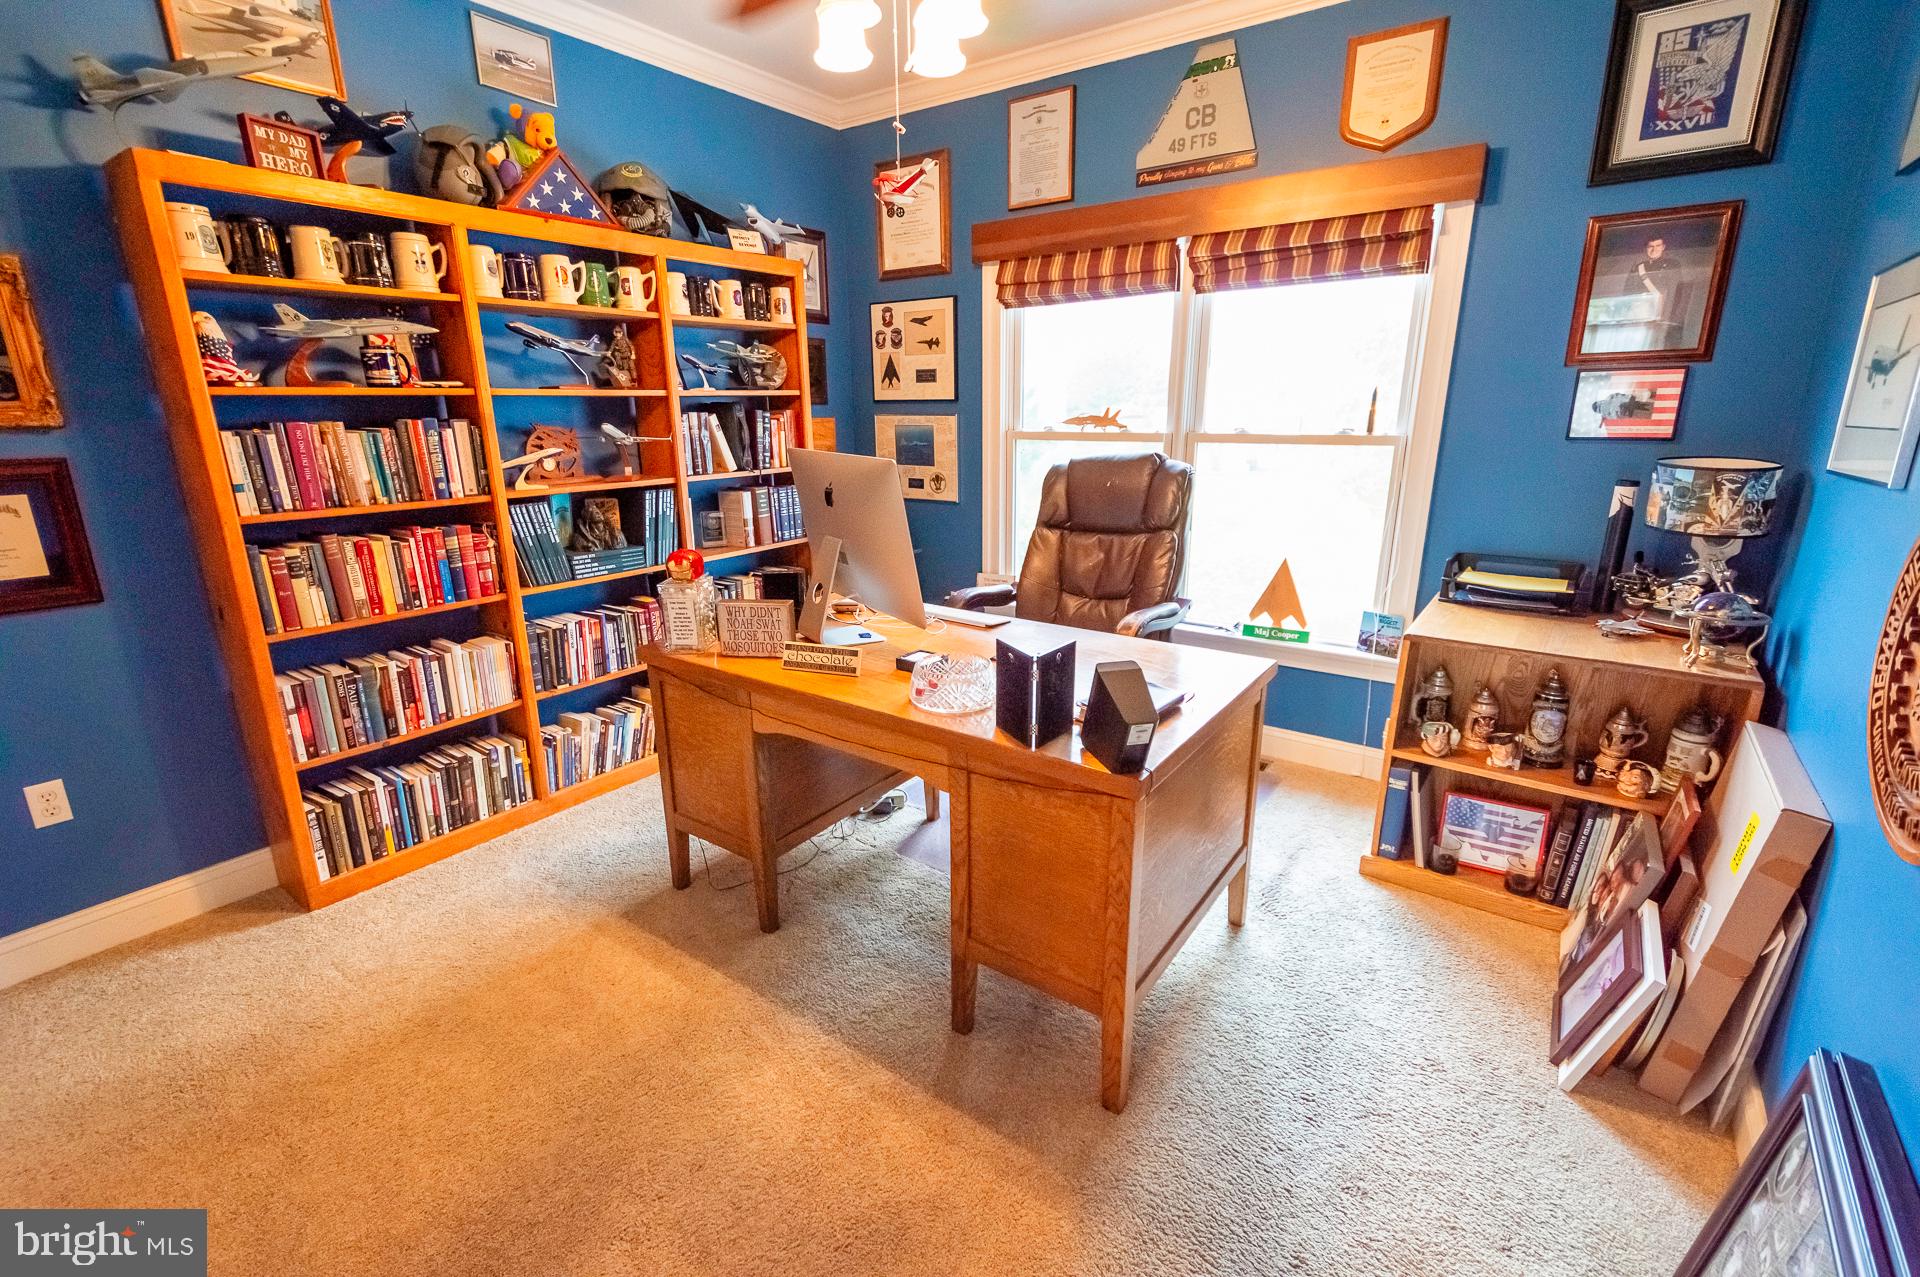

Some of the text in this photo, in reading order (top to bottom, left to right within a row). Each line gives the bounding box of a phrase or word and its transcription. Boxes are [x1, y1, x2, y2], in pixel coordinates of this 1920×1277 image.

[1659, 27, 1692, 53] 85
[1185, 103, 1217, 130] CB
[1656, 111, 1713, 130] XXVII
[254, 125, 307, 149] MY DAD
[1168, 131, 1217, 154] 49 FTS
[288, 146, 308, 161] MY
[259, 151, 313, 177] HERO
[295, 428, 303, 440] NO
[298, 440, 307, 454] ONE
[301, 454, 309, 468] LIKE
[304, 467, 312, 480] HIM
[343, 540, 361, 588] CHURCH HISTORY
[725, 606, 781, 618] WHY DIDN'T
[727, 618, 781, 630] NOAH SWAT
[727, 630, 783, 641] THOSE TWO
[1254, 627, 1300, 639] Maj Cooper
[722, 641, 784, 653] MOSQUITOES
[787, 650, 853, 667] chocolate
[336, 679, 345, 698] MOSES
[347, 684, 359, 707] PAUL
[1582, 818, 1594, 836] UNITED
[1576, 836, 1588, 853] STATES
[1567, 860, 1579, 876] FORCE
[1560, 875, 1574, 899] ACADEMY
